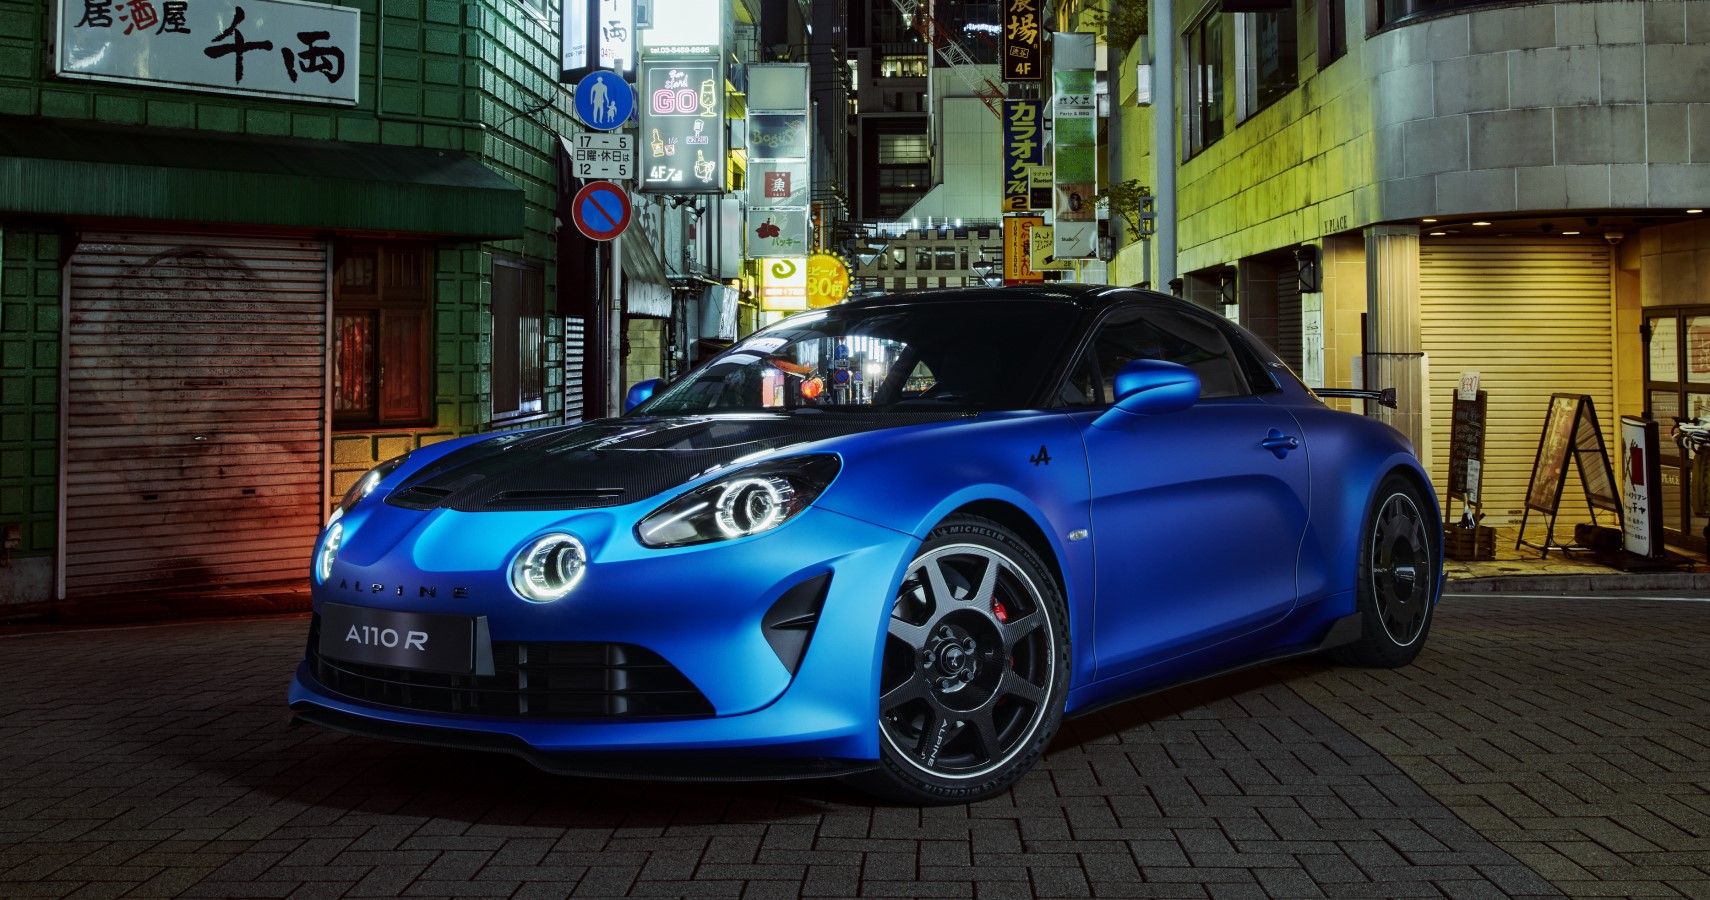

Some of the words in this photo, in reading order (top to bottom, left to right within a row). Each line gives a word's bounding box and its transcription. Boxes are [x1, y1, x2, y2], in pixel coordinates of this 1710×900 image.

[74, 0, 191, 35] 居酒屋
[203, 6, 345, 84] 千両
[1015, 62, 1032, 75] 4F
[653, 89, 698, 113] GO
[580, 136, 592, 147] 17
[619, 137, 627, 148] 5
[1010, 102, 1038, 179] カラオケ
[576, 149, 630, 162] 日曜・休日は
[579, 163, 592, 175] 12
[619, 164, 627, 176] 5
[649, 165, 667, 179] 4F
[773, 178, 785, 191] 魚
[1329, 216, 1348, 233] PLACE
[950, 525, 1005, 542] MICHELIN
[339, 578, 469, 599] ALPINE
[345, 624, 399, 648] A110
[404, 630, 429, 650] R
[927, 718, 948, 767] ALPINE
